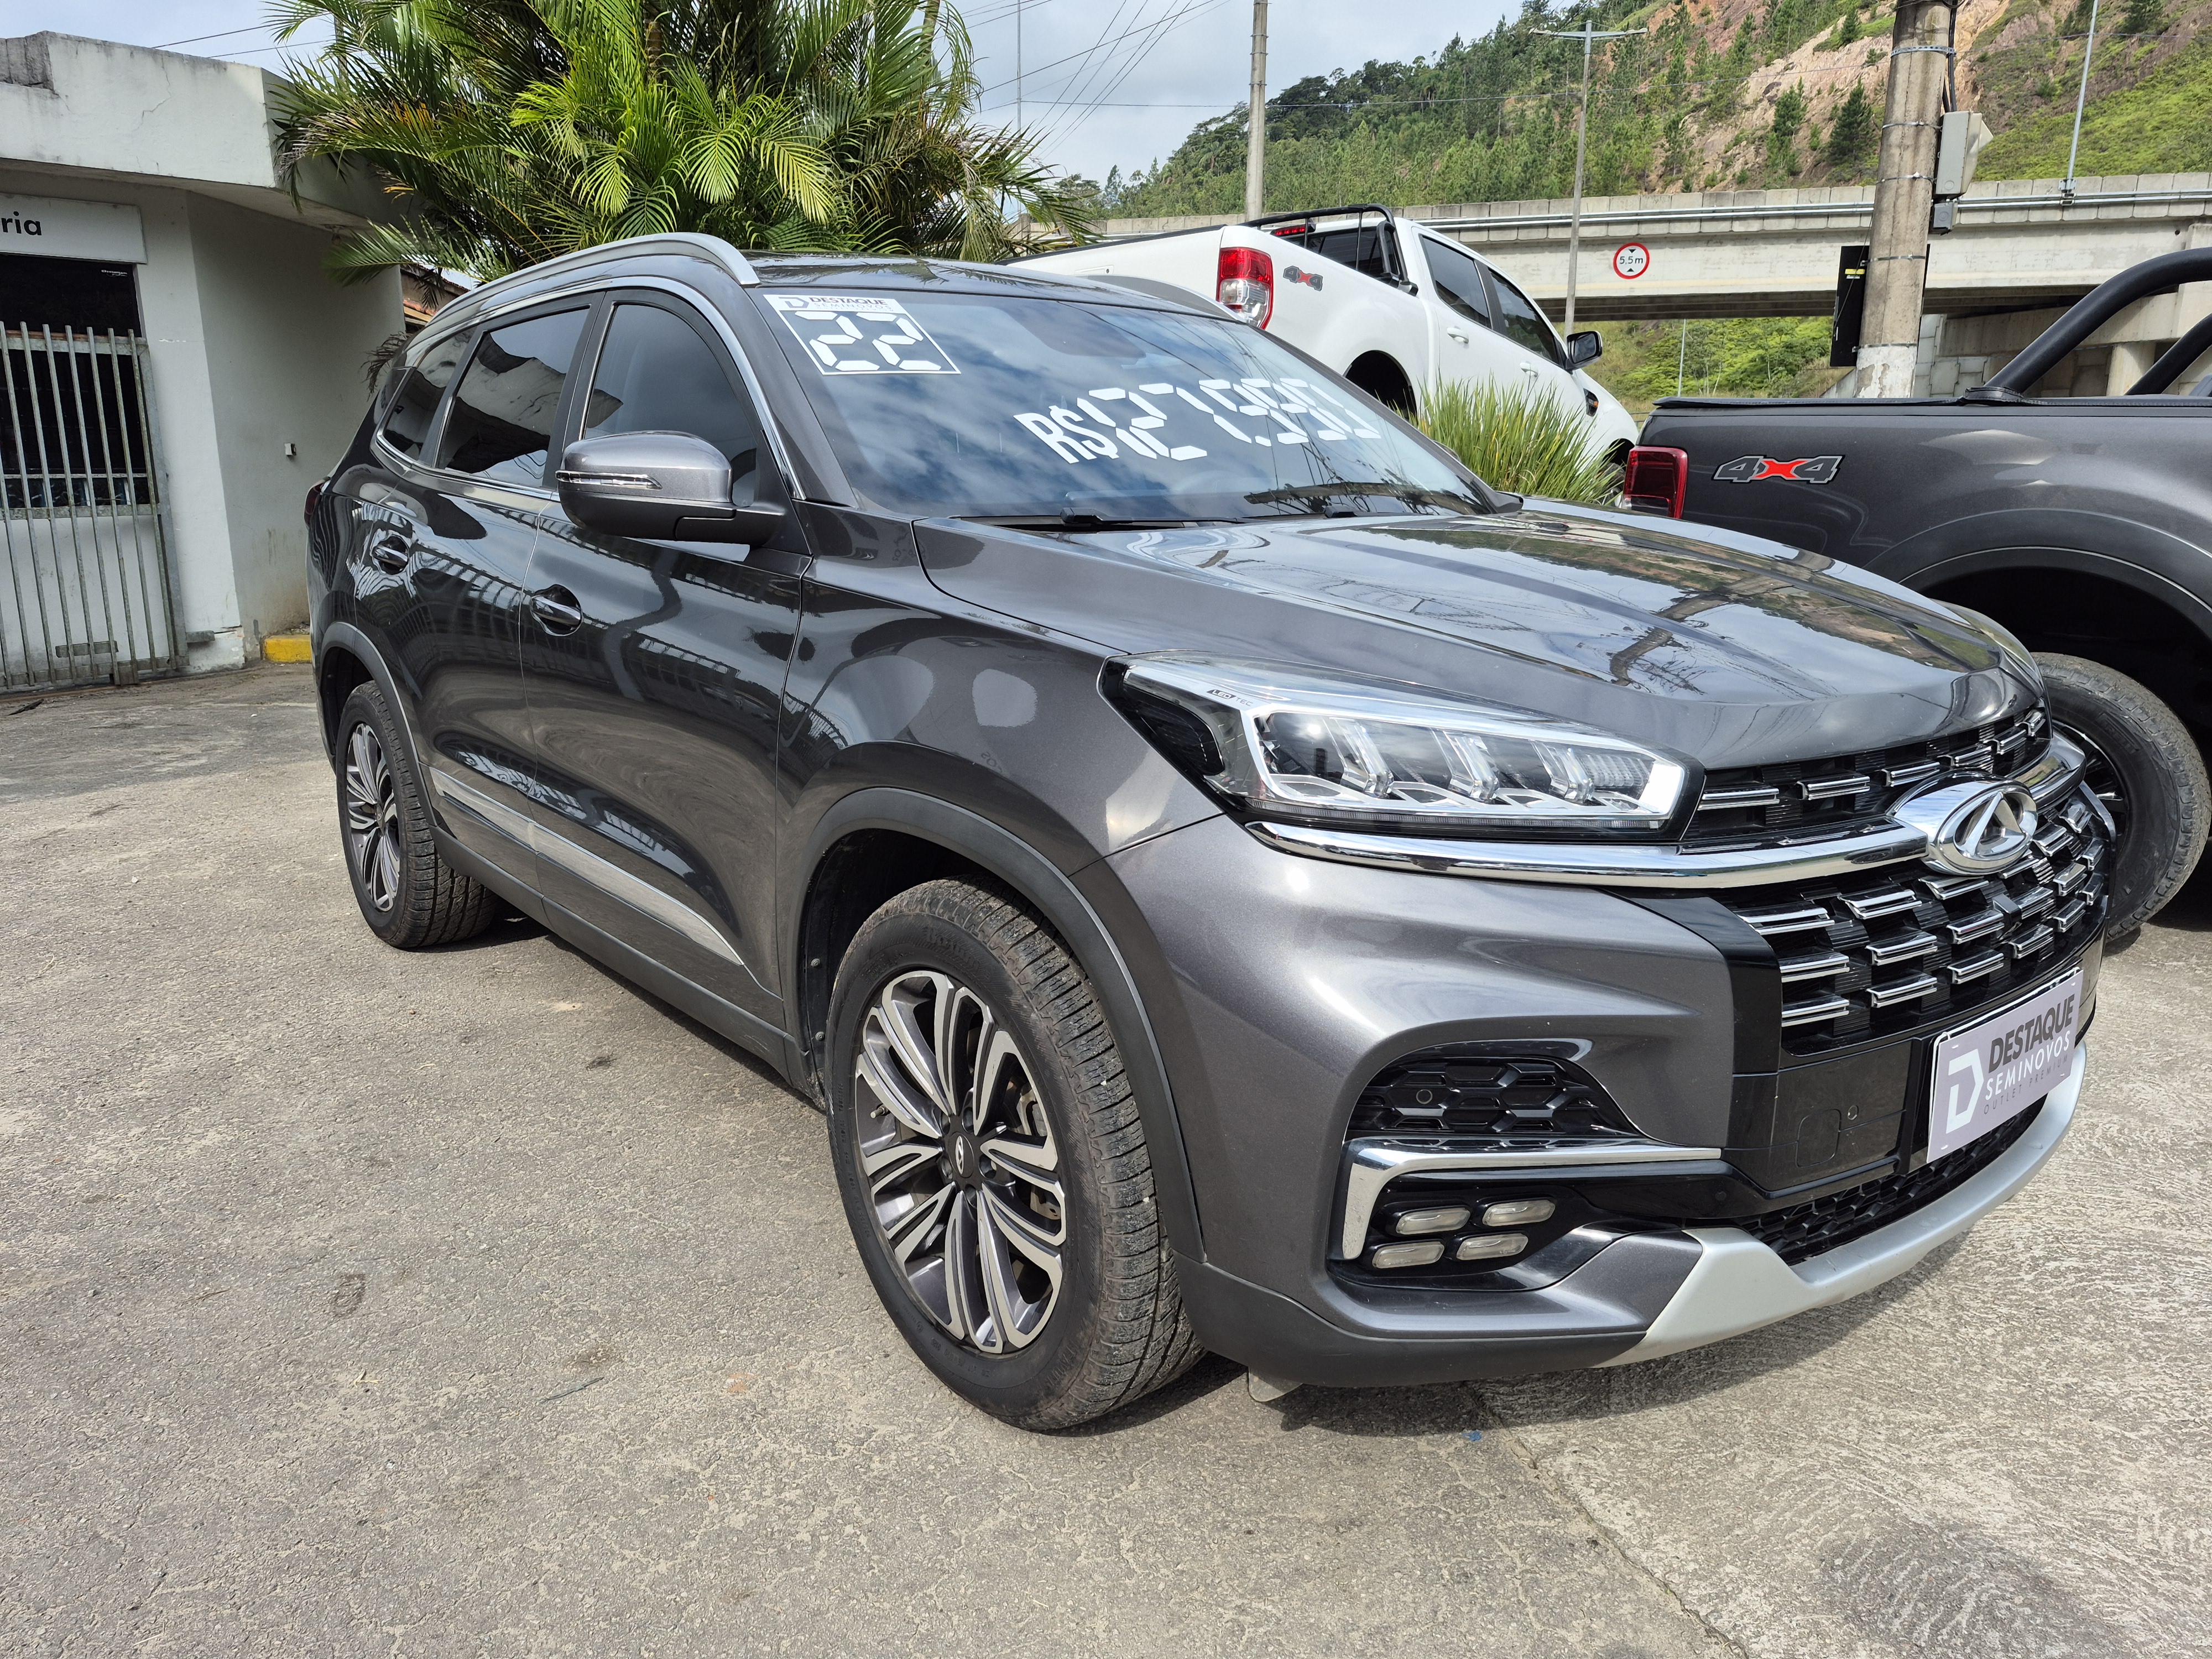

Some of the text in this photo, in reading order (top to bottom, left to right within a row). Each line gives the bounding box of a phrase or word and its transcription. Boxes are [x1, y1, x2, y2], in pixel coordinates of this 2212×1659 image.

[1, 211, 42, 236] ria
[795, 311, 942, 372] 22
[1212, 690, 1253, 707] LED TEC
[1988, 993, 2075, 1073] DESTAQUE
[1984, 1053, 2068, 1115] OUTLET PREMIUM
[1985, 1030, 2070, 1100] SEMINOVOS
